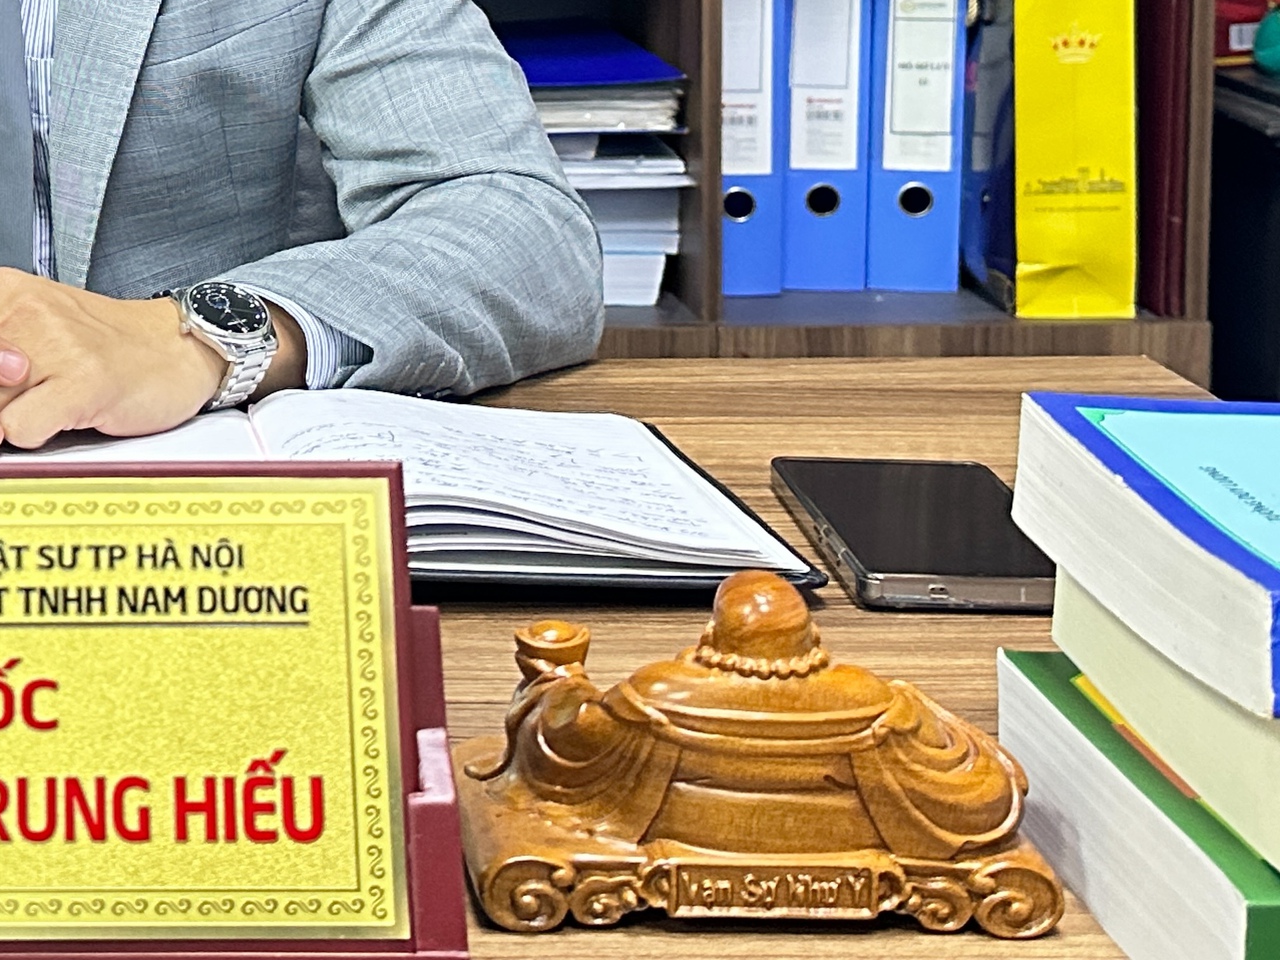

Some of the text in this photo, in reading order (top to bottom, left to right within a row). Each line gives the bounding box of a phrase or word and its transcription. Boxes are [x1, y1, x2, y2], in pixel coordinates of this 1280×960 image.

[37, 543, 81, 571] SƯ
[87, 544, 127, 570] TP
[136, 538, 181, 570] HÀ
[191, 538, 245, 576] NỘI
[18, 586, 107, 616] TNHH
[116, 585, 188, 615] NAM
[197, 584, 310, 615] DƯƠNG
[173, 748, 325, 843] HIẾU
